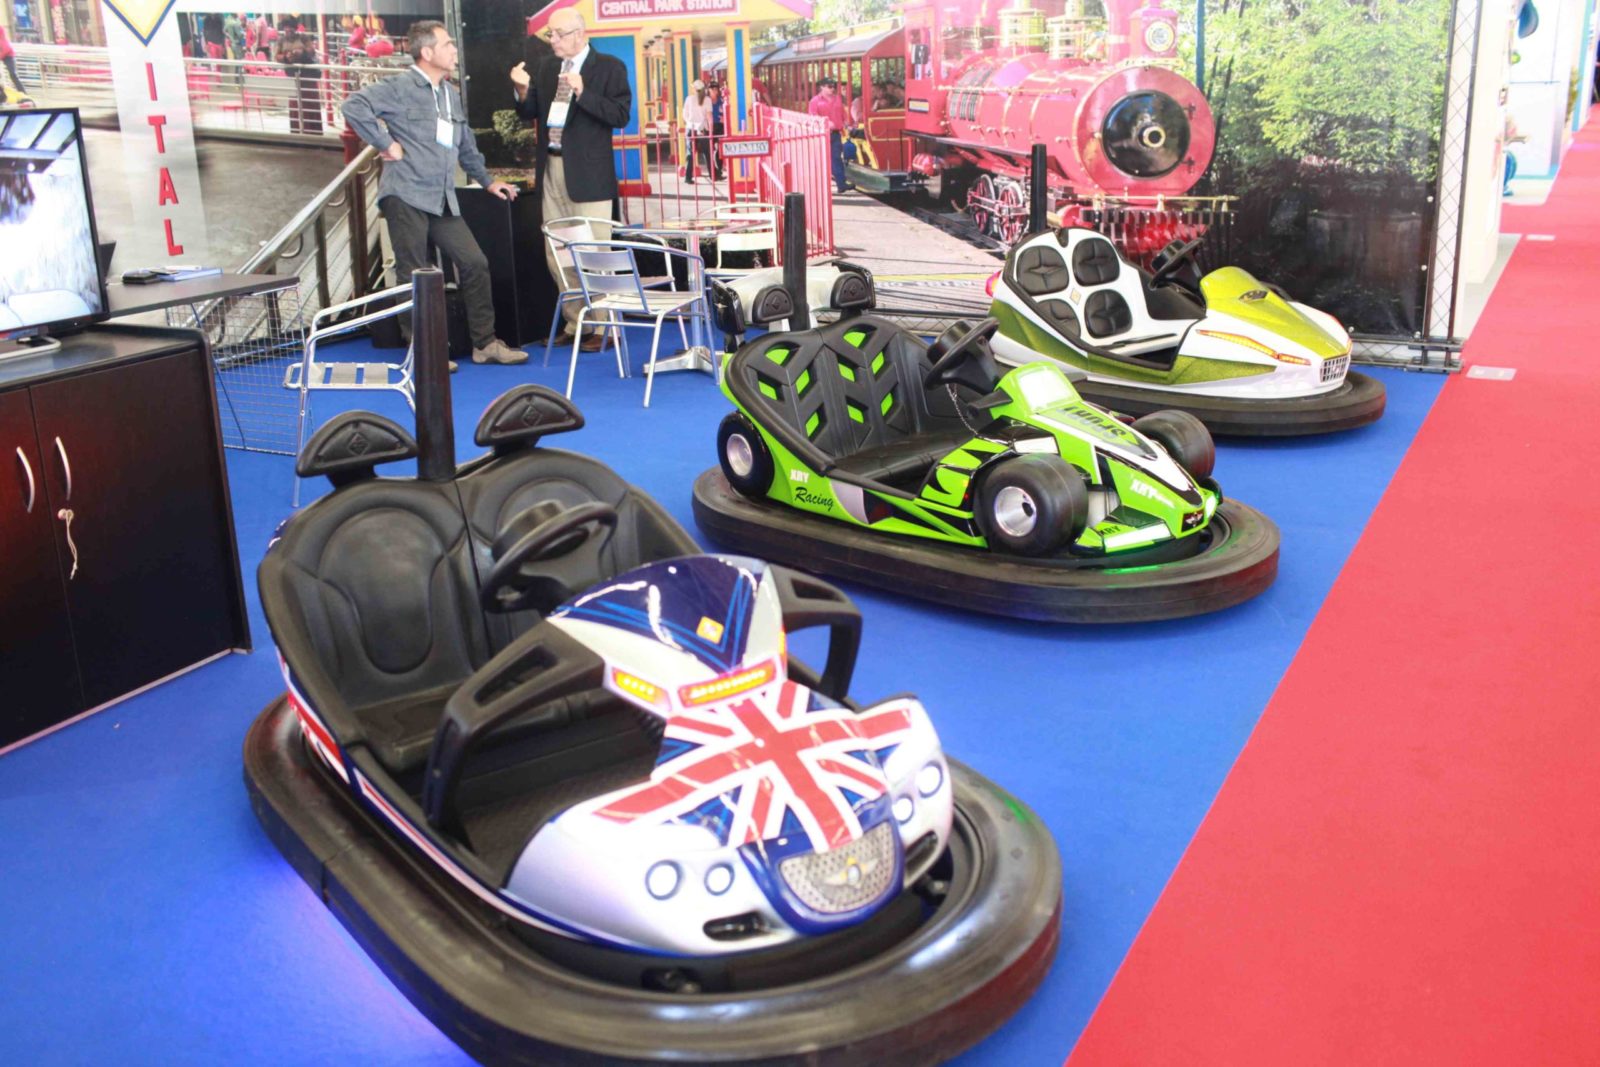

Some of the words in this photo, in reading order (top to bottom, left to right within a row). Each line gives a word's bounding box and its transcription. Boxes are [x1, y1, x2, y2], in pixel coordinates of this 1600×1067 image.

[601, 1, 651, 15] CENTRAL
[654, 0, 684, 12] PARK
[686, 0, 733, 10] STATION
[724, 143, 737, 154] NO
[738, 140, 768, 153] ENTRY
[795, 486, 834, 512] Racing
